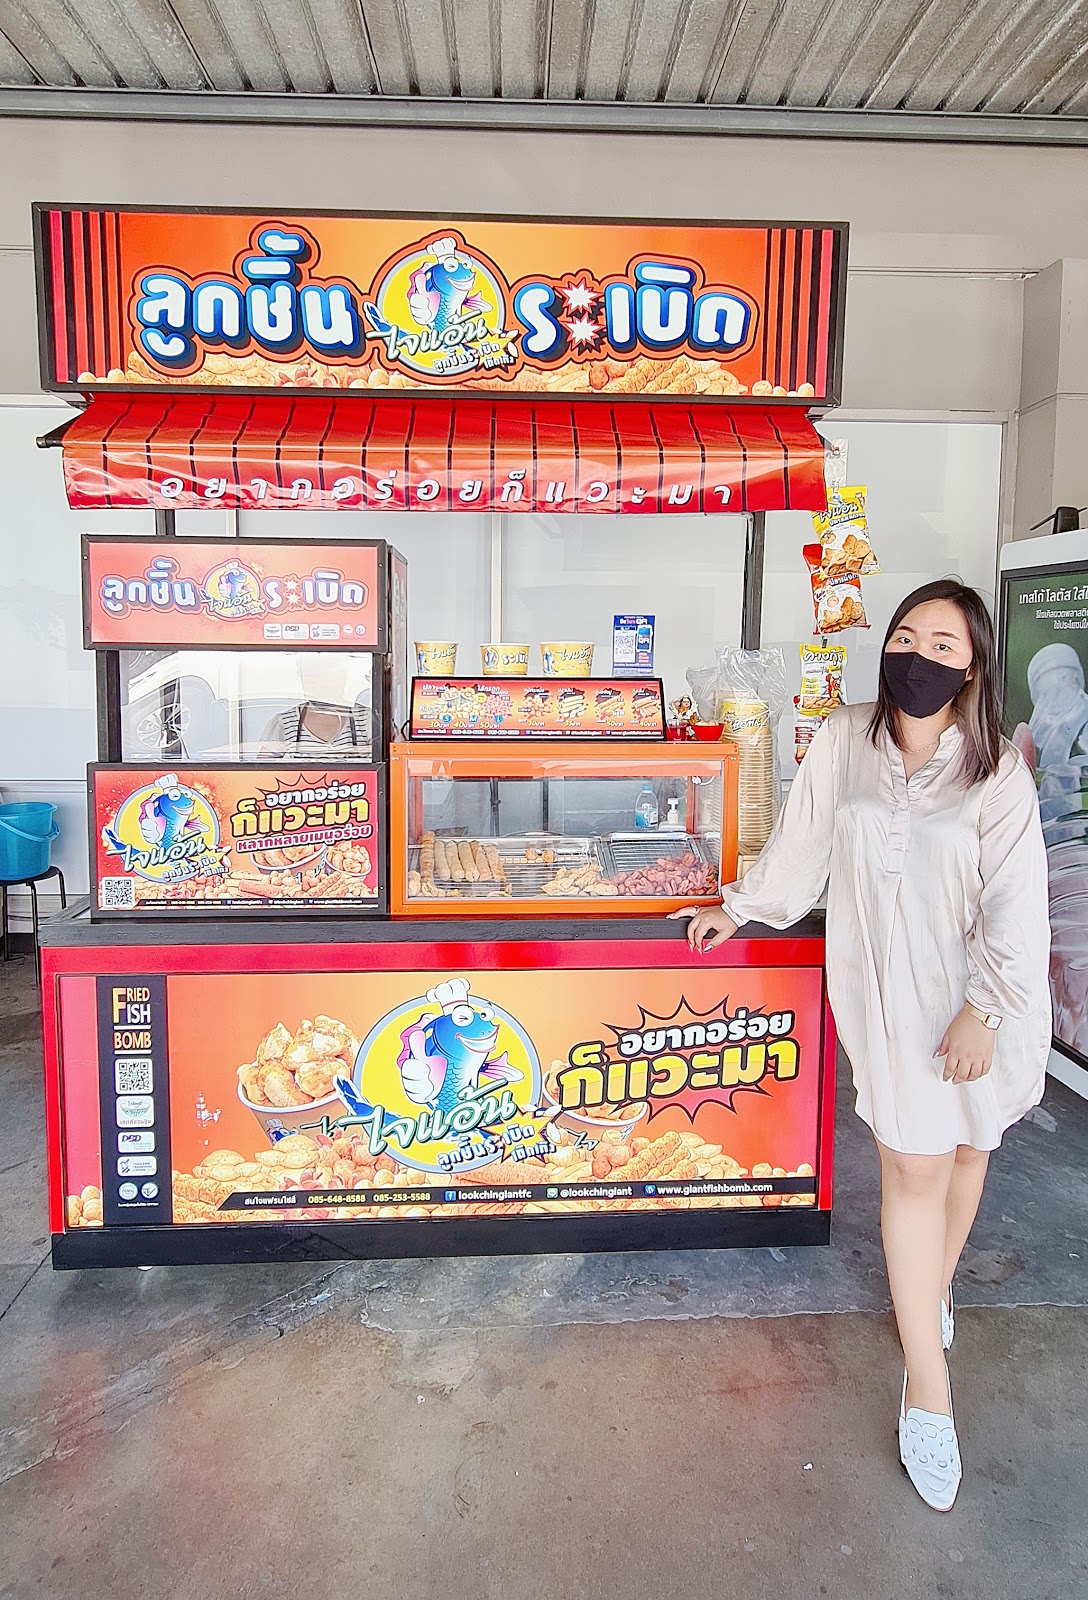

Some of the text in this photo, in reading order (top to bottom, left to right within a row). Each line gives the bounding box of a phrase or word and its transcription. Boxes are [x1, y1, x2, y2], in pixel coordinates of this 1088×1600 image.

[138, 229, 751, 363] ลูกชิ้น ระเบิด
[160, 468, 731, 505] อยากอร่อยก็แวะมา
[102, 558, 365, 612] ลูกชิ้น ระเบิด
[1046, 588, 1071, 602] โลตัส
[265, 780, 366, 808] อยากอร่อย
[231, 798, 370, 837] ก็แวะมา
[237, 823, 372, 852] หลากหลายเมนูอร่อย
[114, 1031, 152, 1049] BOMB
[619, 1008, 793, 1057] อยากอร่อย
[558, 1038, 799, 1109] ก็แวะมา
[307, 1193, 366, 1204] 085-648-8588
[373, 1192, 431, 1203] 085-253-5588
[458, 1187, 532, 1201] lookchingiantfc
[560, 1186, 633, 1199] @lookchingiant
[657, 1183, 773, 1196] www.giantfishbomb.com
